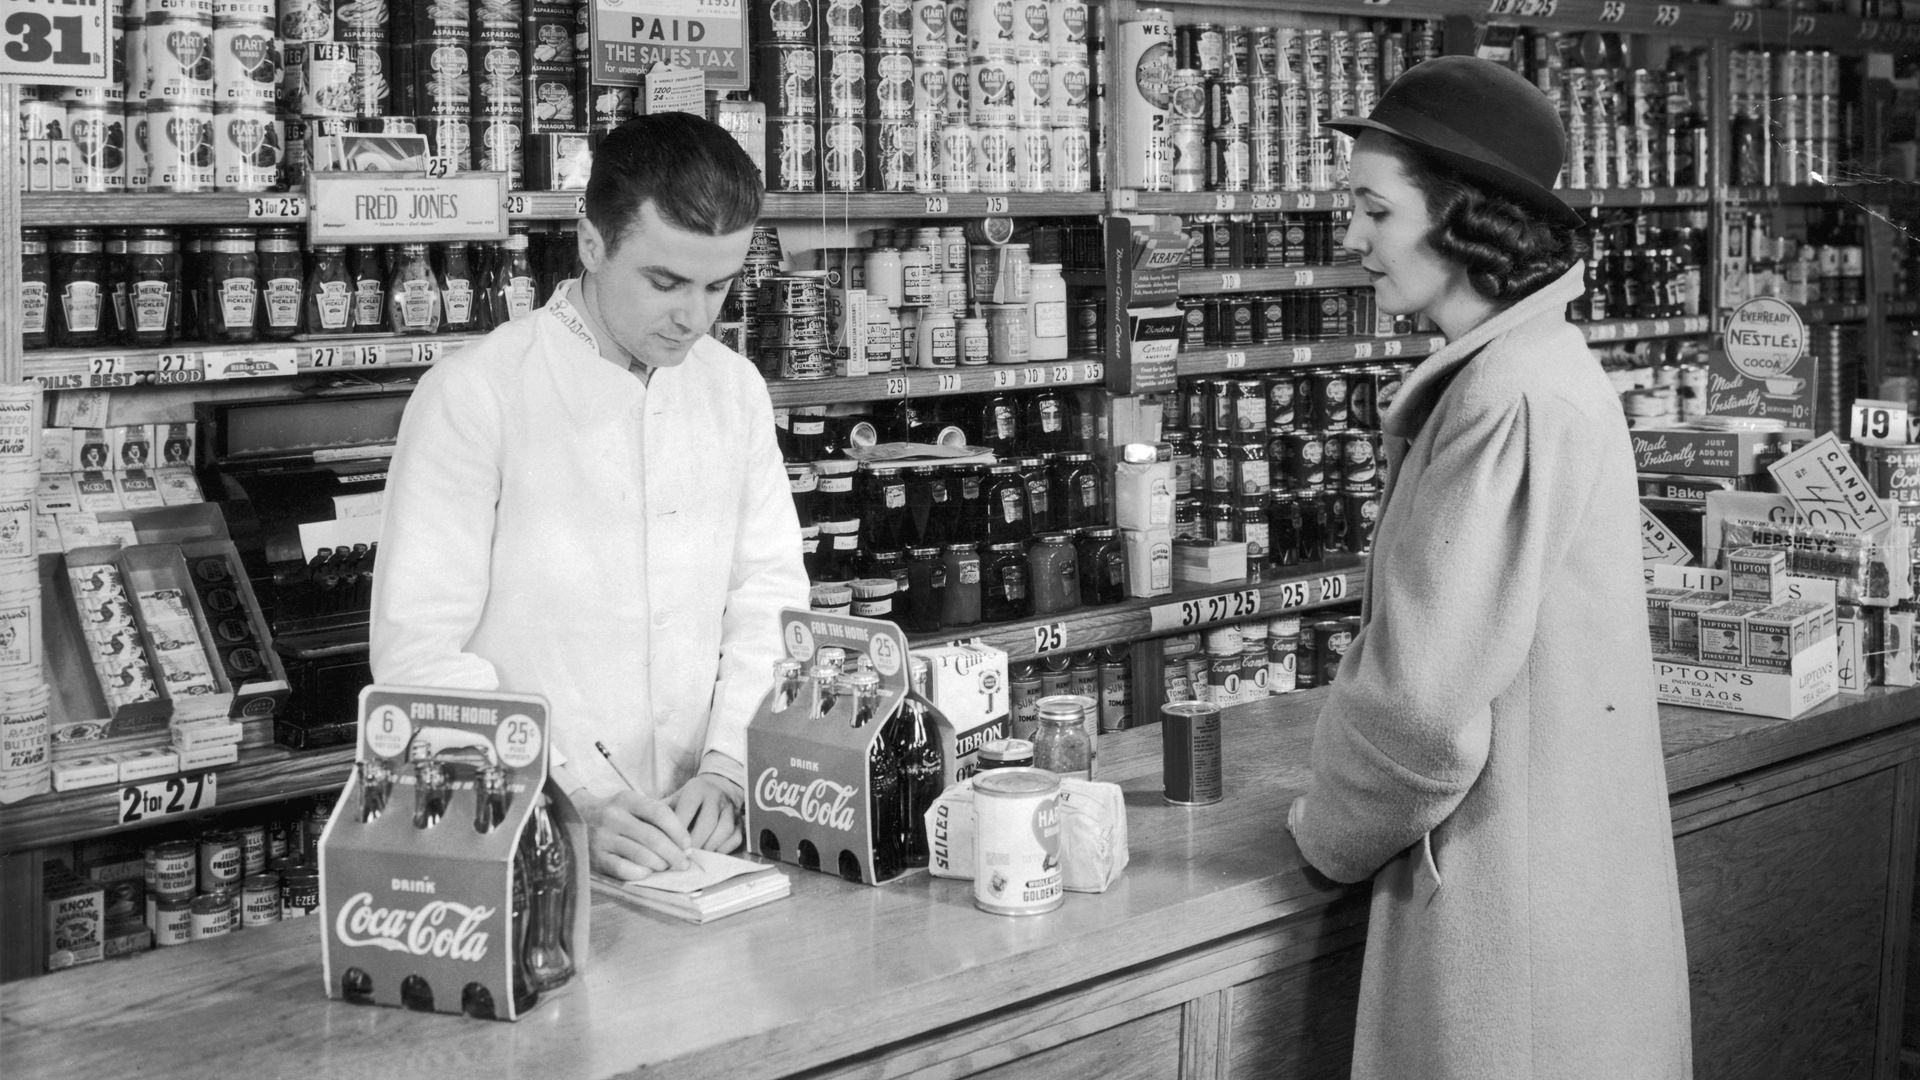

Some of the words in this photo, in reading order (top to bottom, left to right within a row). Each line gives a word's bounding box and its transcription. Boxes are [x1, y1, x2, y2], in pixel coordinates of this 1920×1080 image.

[632, 16, 706, 42] PAID
[1142, 24, 1169, 36] WES
[5, 12, 91, 64] 31
[171, 35, 201, 47] HART
[234, 39, 264, 51] HART
[605, 44, 635, 62] THE
[640, 47, 692, 67] SALES
[696, 49, 736, 67] TAX
[604, 62, 615, 72] for
[619, 67, 648, 75] unemplo
[981, 71, 1005, 83] HART
[429, 159, 448, 176] 25
[254, 198, 264, 216] 3
[265, 201, 278, 214] for
[280, 198, 300, 216] 25
[355, 194, 398, 220] FRED
[408, 194, 458, 219] JONES
[508, 196, 524, 213] 29
[929, 198, 943, 212] 23
[990, 197, 1002, 212] 15
[1149, 252, 1184, 264] KRAFT
[140, 287, 161, 295] HEINZ
[315, 347, 334, 367] 27
[361, 346, 377, 365] 15
[418, 343, 433, 361] 15
[93, 359, 115, 373] 27
[162, 355, 186, 370] 27
[230, 363, 255, 371] BIRDS
[1743, 358, 1780, 369] COCOA
[158, 369, 202, 384] MOD
[1000, 371, 1007, 384] 9
[1055, 368, 1068, 381] 23
[1086, 365, 1098, 378] 35
[90, 372, 133, 387] BEST
[890, 379, 903, 393] 29
[943, 375, 954, 389] 17
[1710, 373, 1744, 392] Made
[1707, 388, 1760, 415] Instantly
[1759, 402, 1766, 415] 3
[1859, 407, 1890, 438] 19
[1633, 435, 1667, 454] Made
[1640, 443, 1697, 467] Instantly
[83, 483, 111, 491] KOOL
[126, 481, 152, 489] KOOL
[1827, 452, 1877, 514] CANDY
[1667, 485, 1706, 499] Bake
[1643, 521, 1678, 553] NDY
[1752, 531, 1837, 553] HERSHEY'S
[1733, 562, 1768, 574] LIPTON
[1284, 585, 1304, 608] 25
[1321, 578, 1342, 600] 20
[1182, 604, 1201, 626] 31
[1208, 600, 1229, 622] 27
[1233, 592, 1255, 616] 25
[1650, 600, 1669, 609] IPTO
[1673, 610, 1697, 618] LIPTO
[811, 621, 828, 635] FOR
[827, 622, 845, 638] THE
[844, 625, 870, 641] HOME
[1703, 619, 1739, 630] LIPTON'S
[1751, 624, 1788, 634] LIPTON'S
[794, 624, 803, 644] 6
[1038, 628, 1061, 650] 25
[1703, 653, 1726, 661] FINEST
[1752, 657, 1774, 665] FINEST
[1660, 664, 1754, 686] PTON'S
[1672, 678, 1715, 688] INDIVIDUAL
[1658, 683, 1682, 694] EA
[1691, 686, 1742, 702] BAGS
[410, 702, 435, 720] FOR
[436, 704, 460, 722] THE
[460, 707, 498, 725] HOME
[383, 710, 394, 733] 6
[507, 720, 529, 744] 25
[11, 752, 44, 767] FLAVOR
[790, 757, 820, 772] DRINK
[122, 787, 143, 823] 2
[143, 790, 162, 812] for
[165, 777, 205, 814] 27
[754, 767, 859, 832] Coca-Cola
[936, 804, 949, 870] SLICED
[166, 861, 189, 871] JELL-O
[391, 876, 436, 893] DRINK
[295, 895, 317, 906] E-ZEE
[1023, 887, 1054, 902] GOLDEN
[60, 896, 94, 914] KNOX
[336, 892, 497, 962] Coca-Cola
